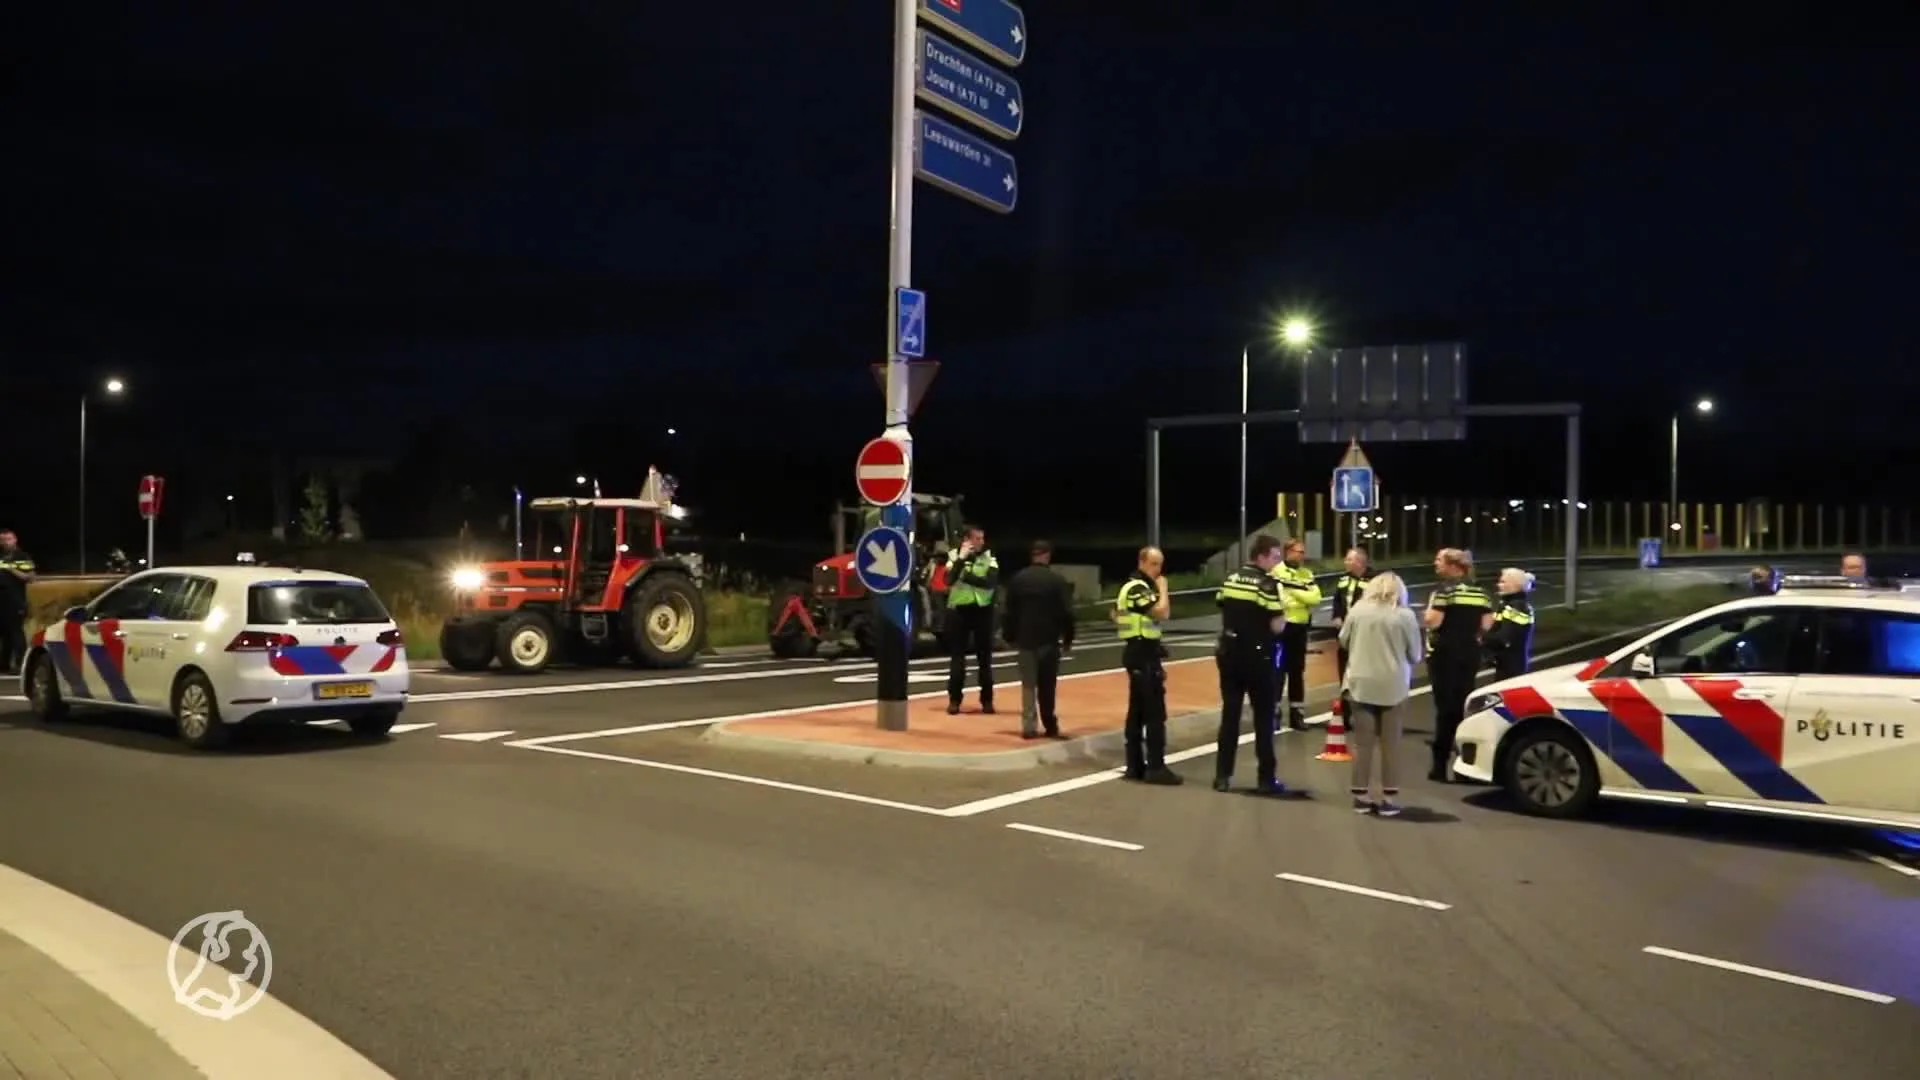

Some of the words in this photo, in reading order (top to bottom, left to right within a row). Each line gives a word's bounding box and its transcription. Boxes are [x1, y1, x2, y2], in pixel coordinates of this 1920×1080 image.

[926, 42, 973, 79] Drachten
[926, 69, 956, 94] Joure
[924, 123, 981, 163] Leeuwarden
[1797, 717, 1905, 741] POLITIE
